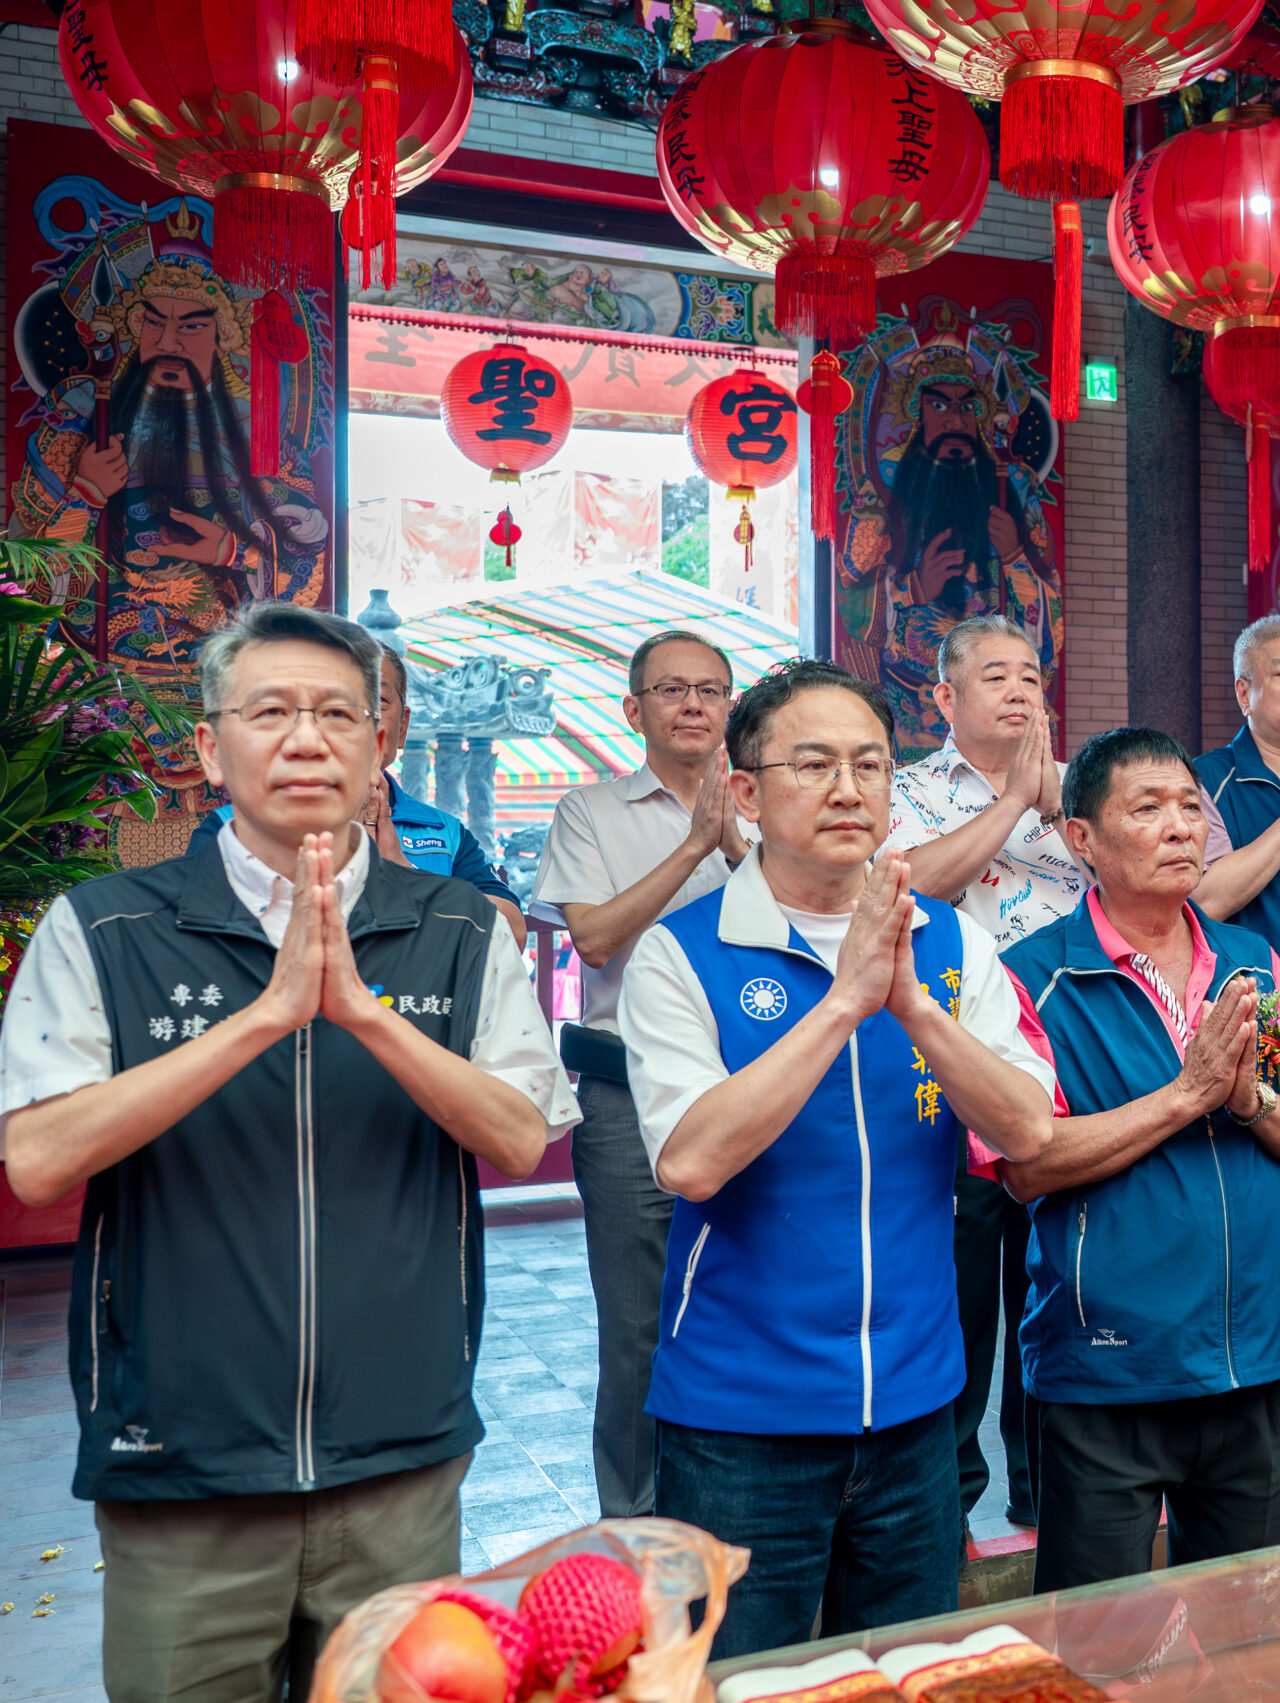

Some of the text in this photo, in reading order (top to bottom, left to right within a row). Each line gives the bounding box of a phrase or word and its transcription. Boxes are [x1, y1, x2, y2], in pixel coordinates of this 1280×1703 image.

[65, 0, 108, 92] 聖母
[468, 358, 555, 446] 聖
[720, 383, 799, 465] 宮
[416, 839, 442, 848] Sheng
[148, 1014, 232, 1042] 游建
